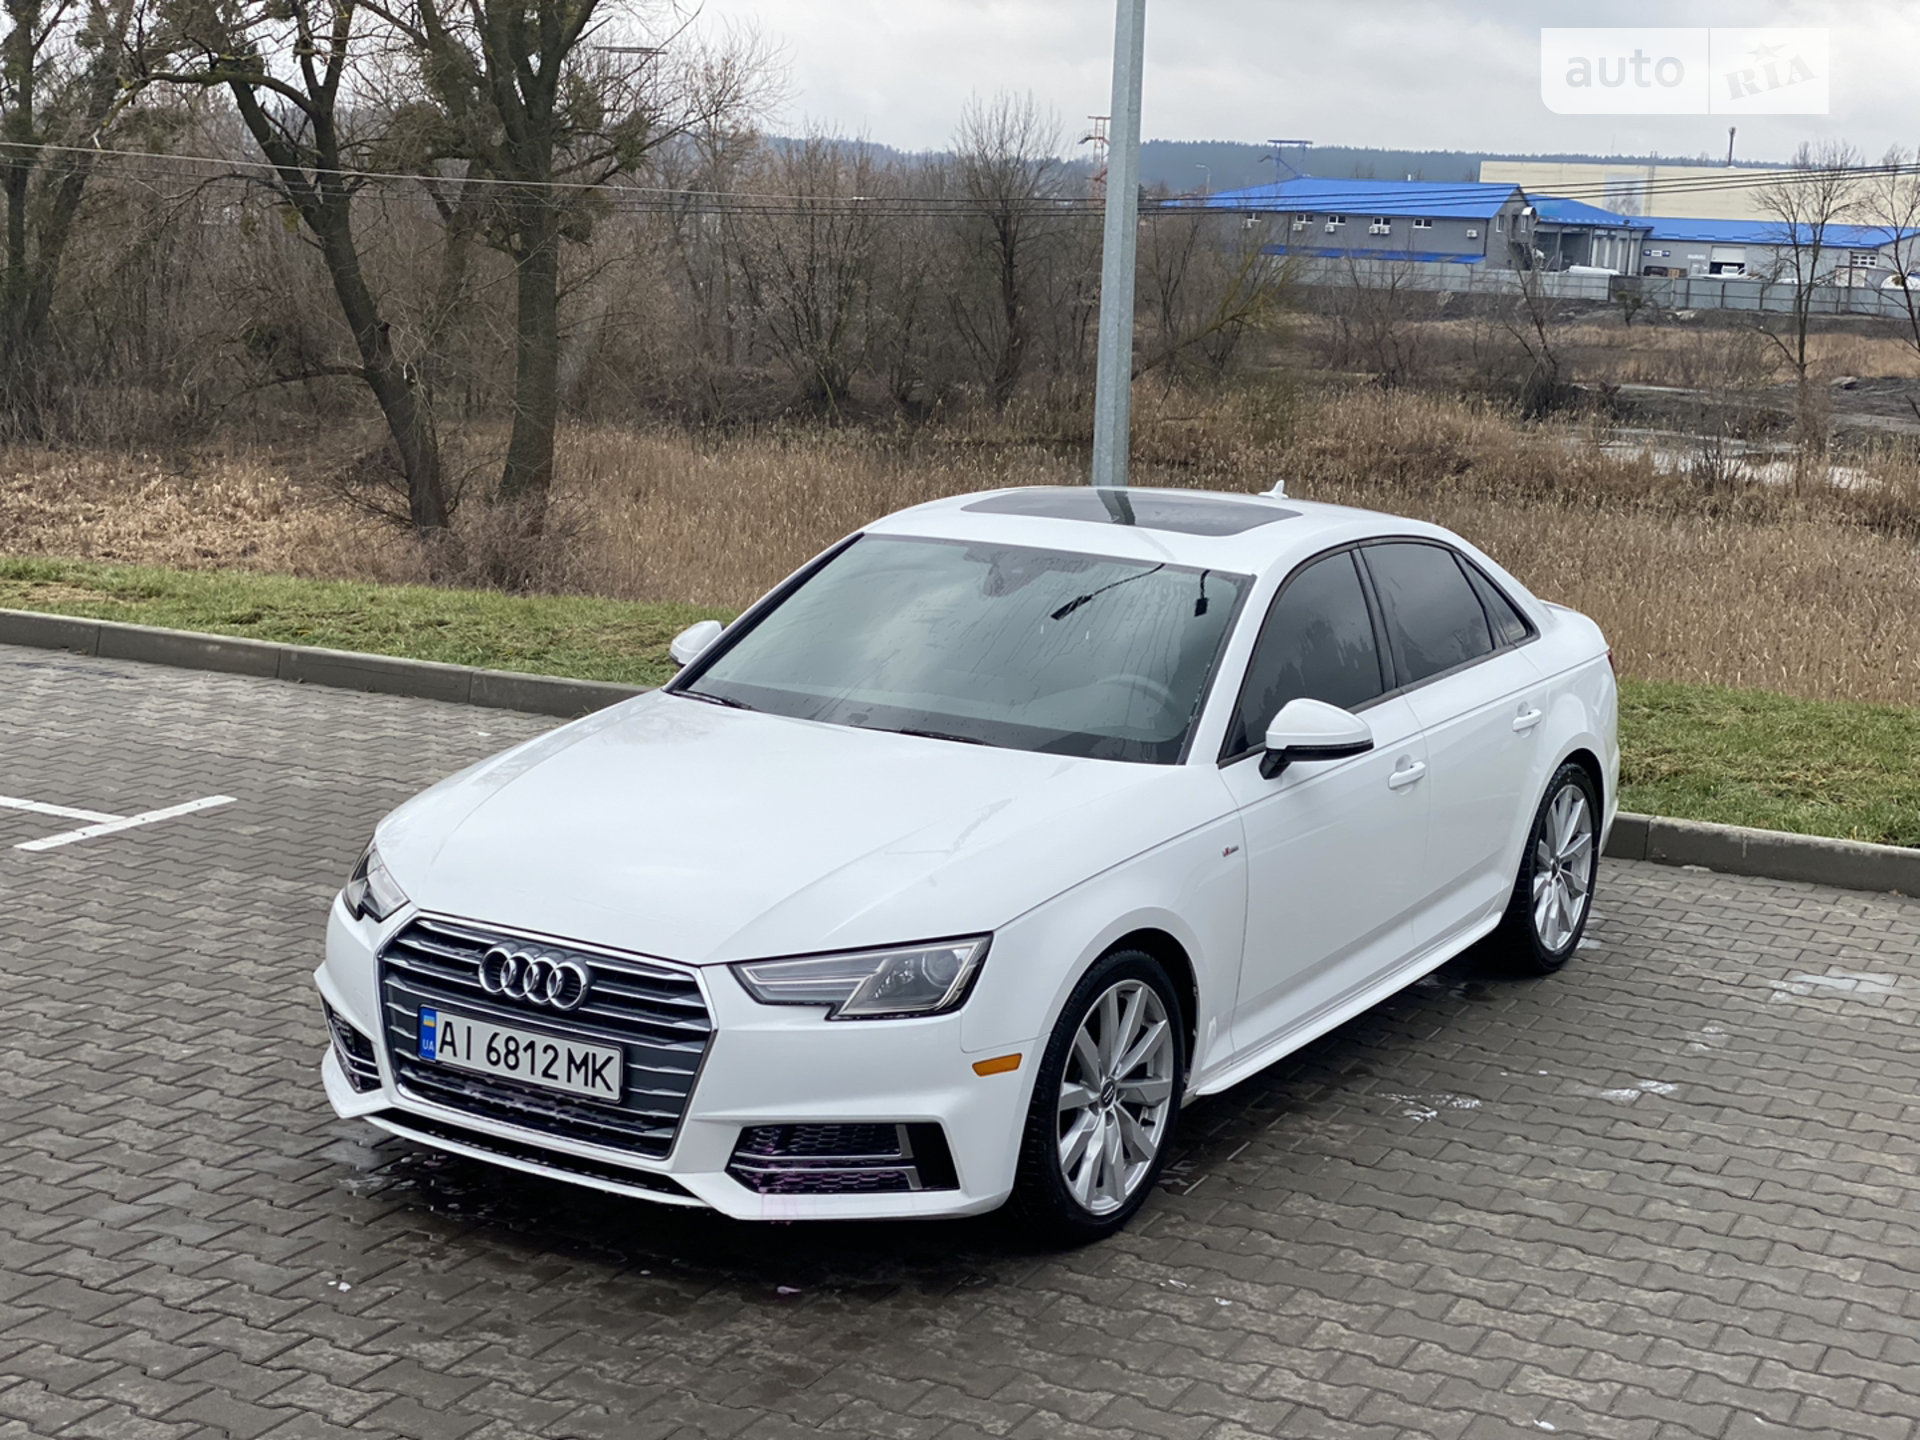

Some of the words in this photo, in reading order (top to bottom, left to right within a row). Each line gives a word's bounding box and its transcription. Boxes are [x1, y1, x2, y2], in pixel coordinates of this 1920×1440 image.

[422, 1038, 435, 1052] UA
[438, 1021, 472, 1061] AI
[486, 1032, 559, 1080] 6812
[566, 1048, 614, 1092] MK
